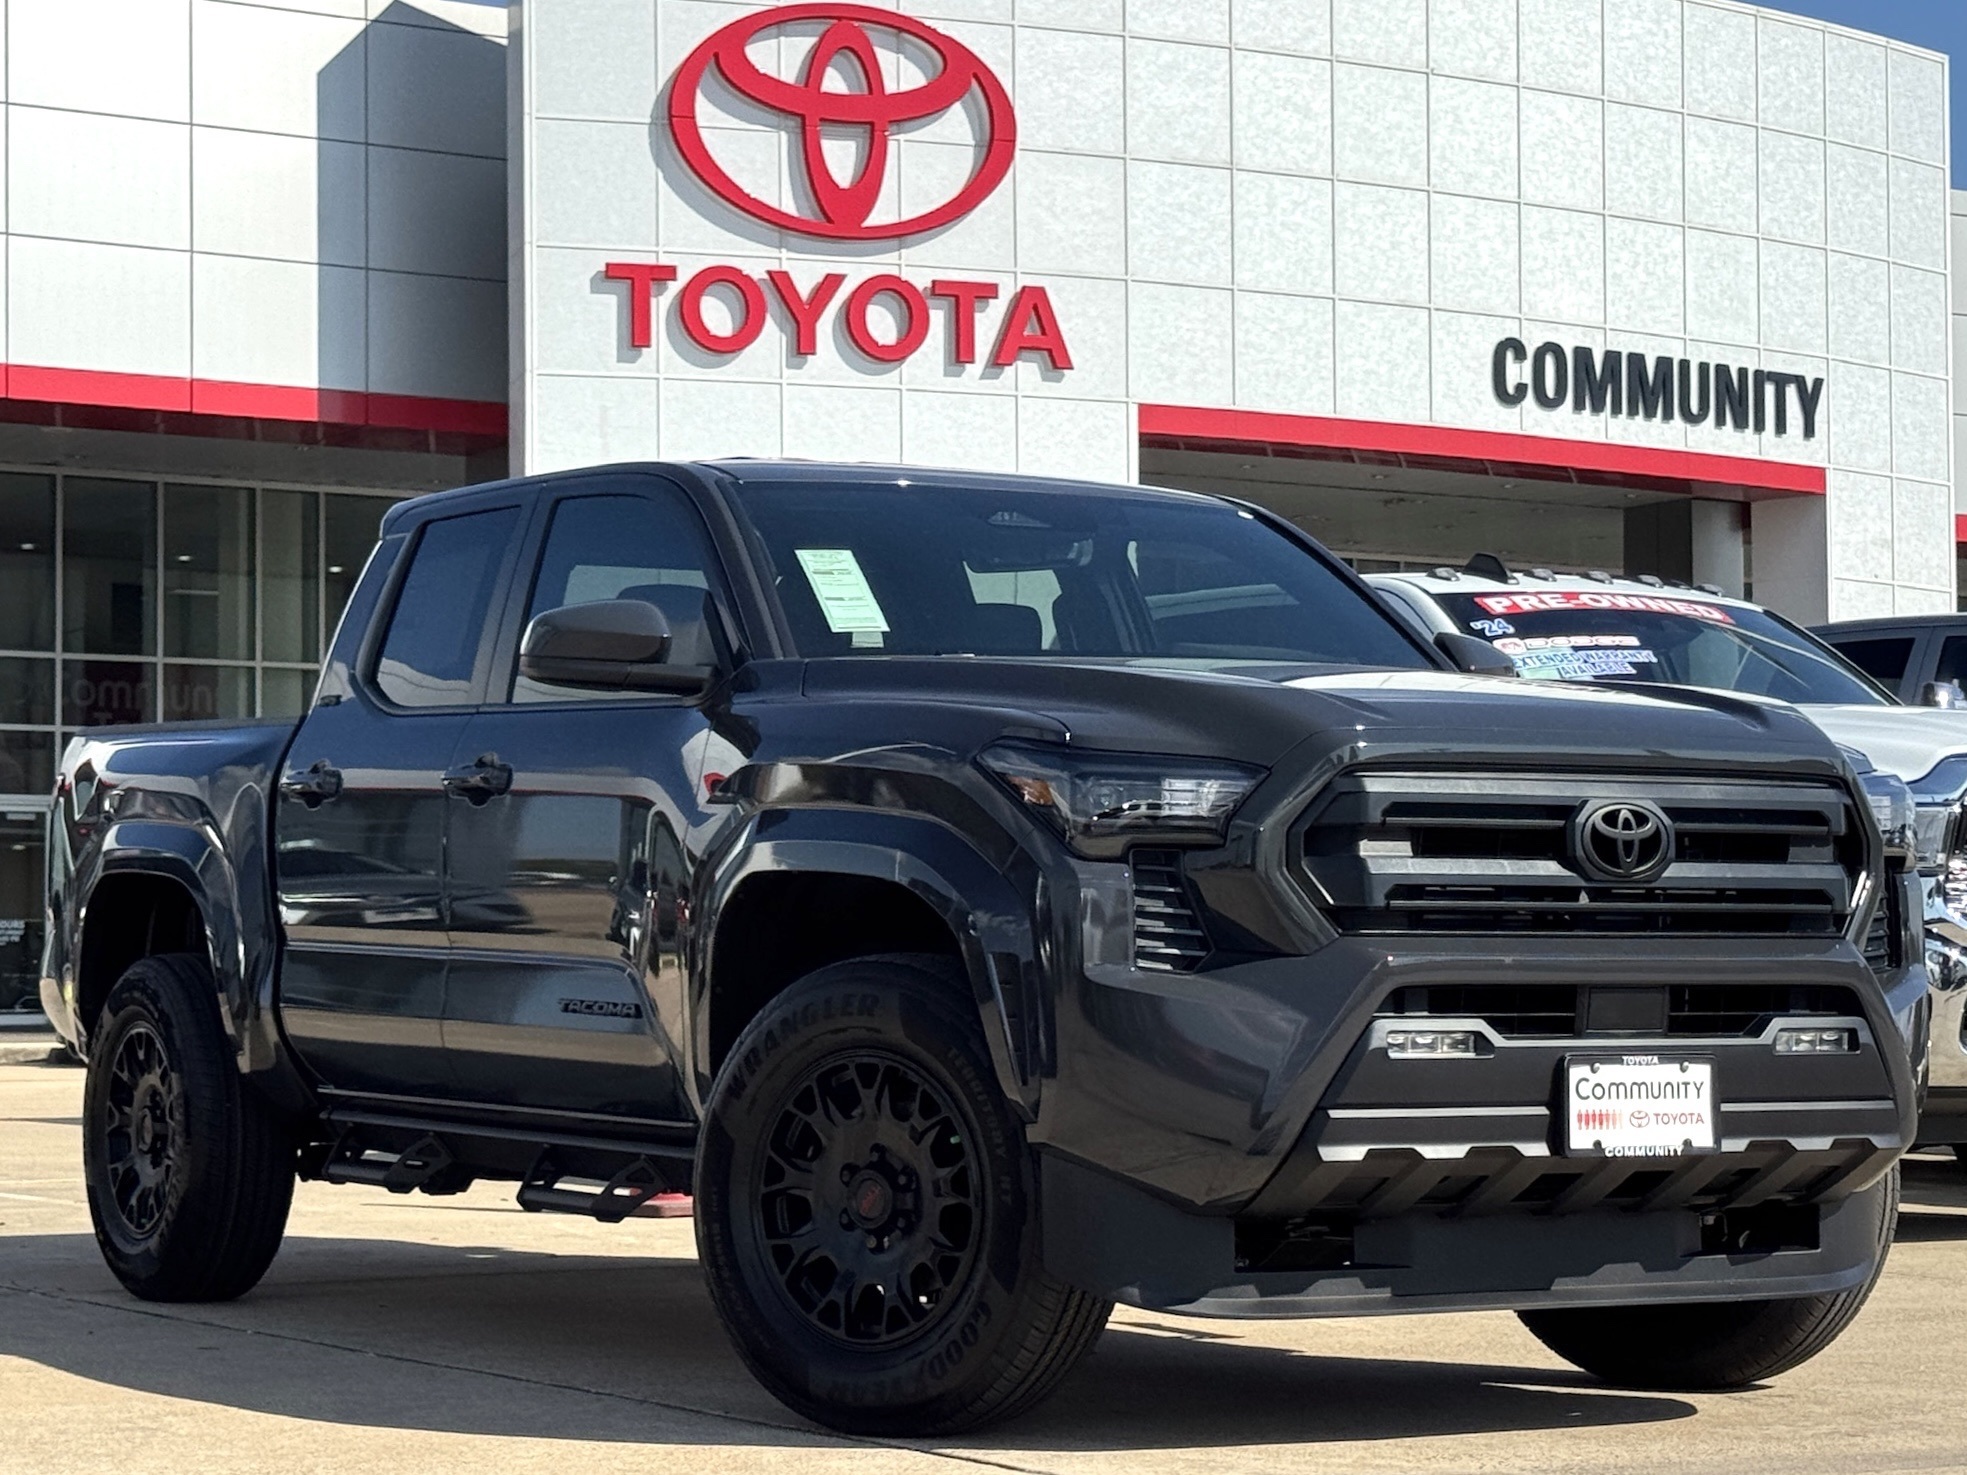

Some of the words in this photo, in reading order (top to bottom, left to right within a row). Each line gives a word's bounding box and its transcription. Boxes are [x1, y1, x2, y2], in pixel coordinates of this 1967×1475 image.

[604, 262, 1074, 371] TOYOTA
[1492, 337, 1824, 440] COMMUNITY
[1483, 593, 1724, 620] PRE-OWNED
[1514, 652, 1582, 669] EXTENDED
[1581, 650, 1656, 663] WARRANTY
[1561, 662, 1633, 676] AVAILABLE
[558, 999, 637, 1018] TACOMA
[725, 993, 880, 1102] WRANGLER
[1622, 1056, 1660, 1066] TOYOTA
[1653, 1112, 1705, 1126] TOYOTA
[1604, 1145, 1684, 1158] COMMUNITY
